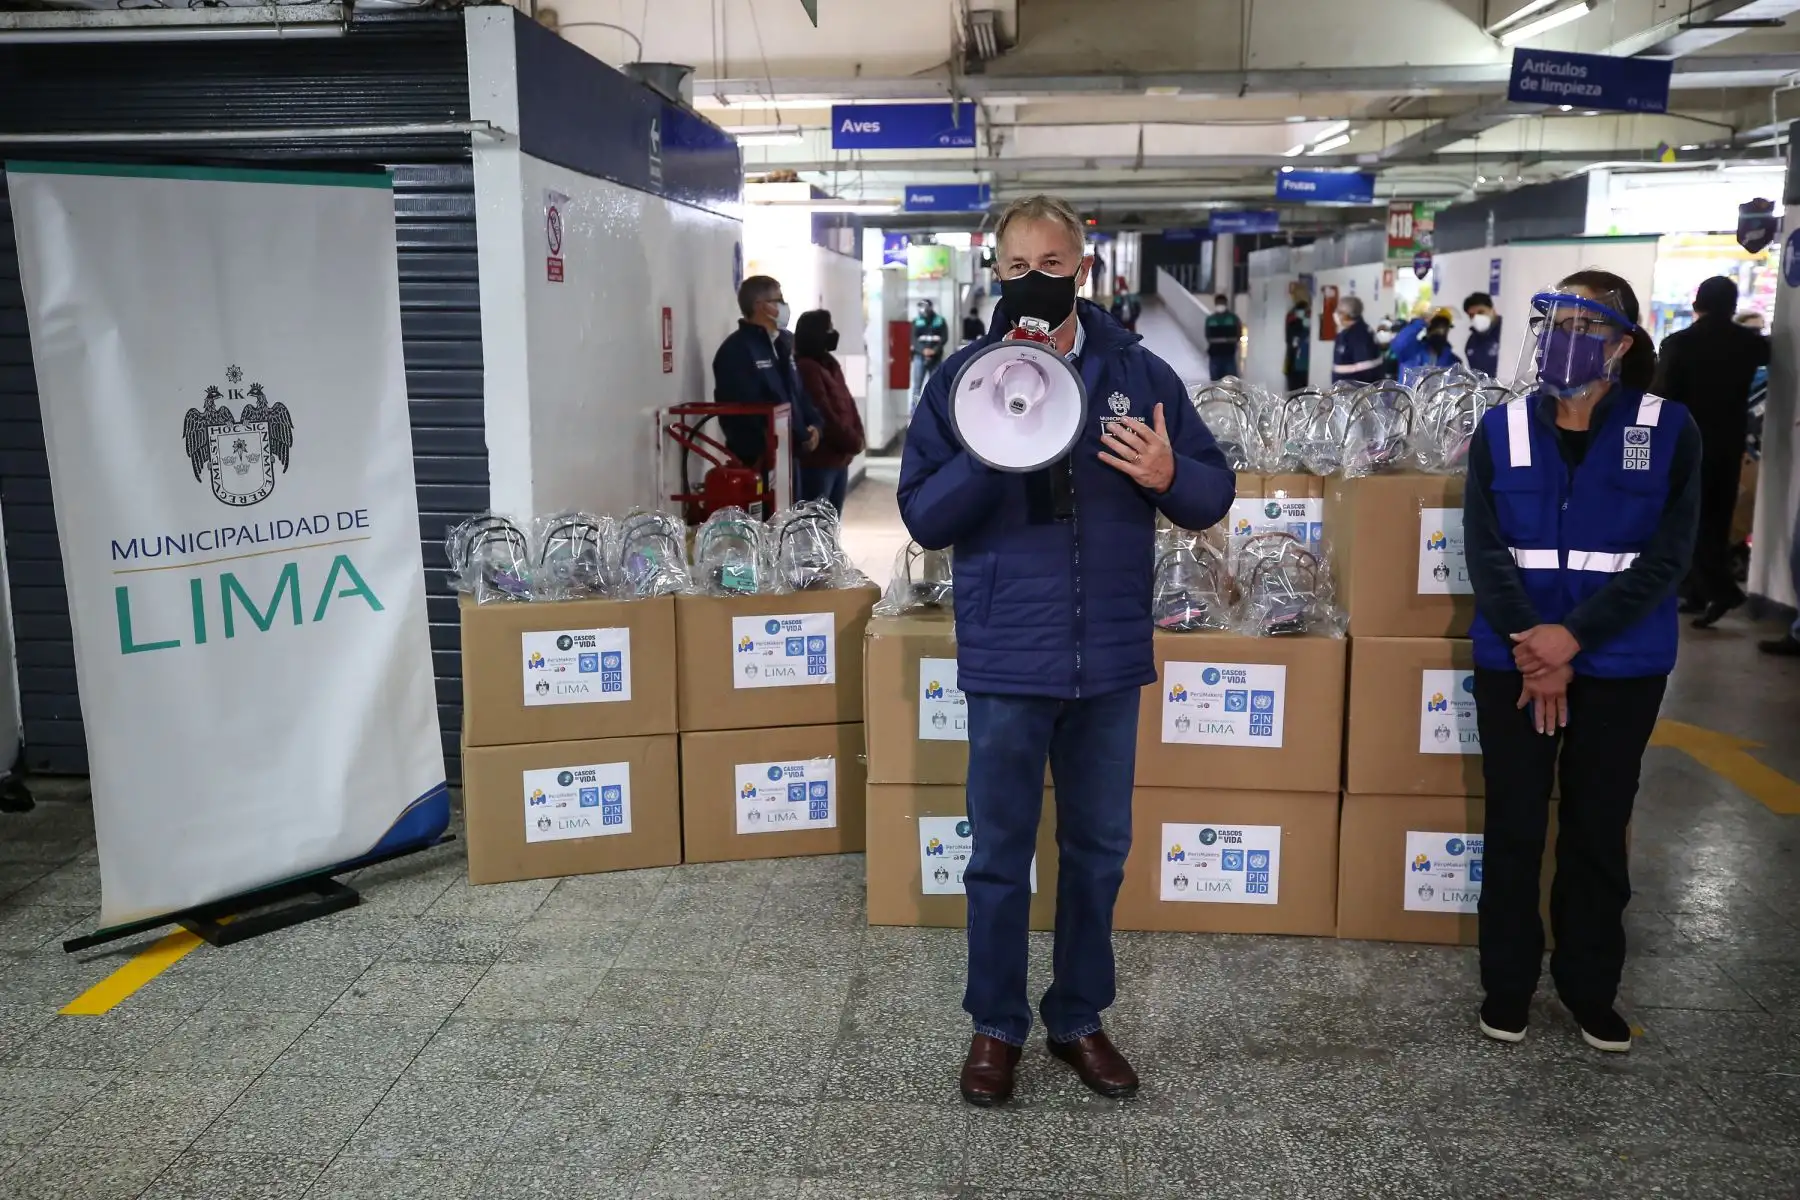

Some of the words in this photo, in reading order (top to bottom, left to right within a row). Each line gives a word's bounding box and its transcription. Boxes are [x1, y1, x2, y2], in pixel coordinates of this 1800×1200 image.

[1520, 76, 1538, 91] de
[1541, 78, 1602, 96] limpieza
[841, 119, 881, 133] Aves
[228, 388, 245, 400] IK
[111, 514, 330, 560] MUNICIPALIDAD
[336, 509, 370, 531] DE
[115, 554, 385, 655] LIMA
[765, 667, 796, 677] LIMA
[1227, 676, 1247, 684] VIDA
[557, 684, 589, 694] LIMA
[955, 719, 966, 729] LI
[1198, 723, 1235, 735] LIMA
[579, 775, 597, 783] VIDA
[767, 812, 798, 823] LIMA
[558, 818, 591, 830] LIMA
[1196, 881, 1232, 892] LIMA
